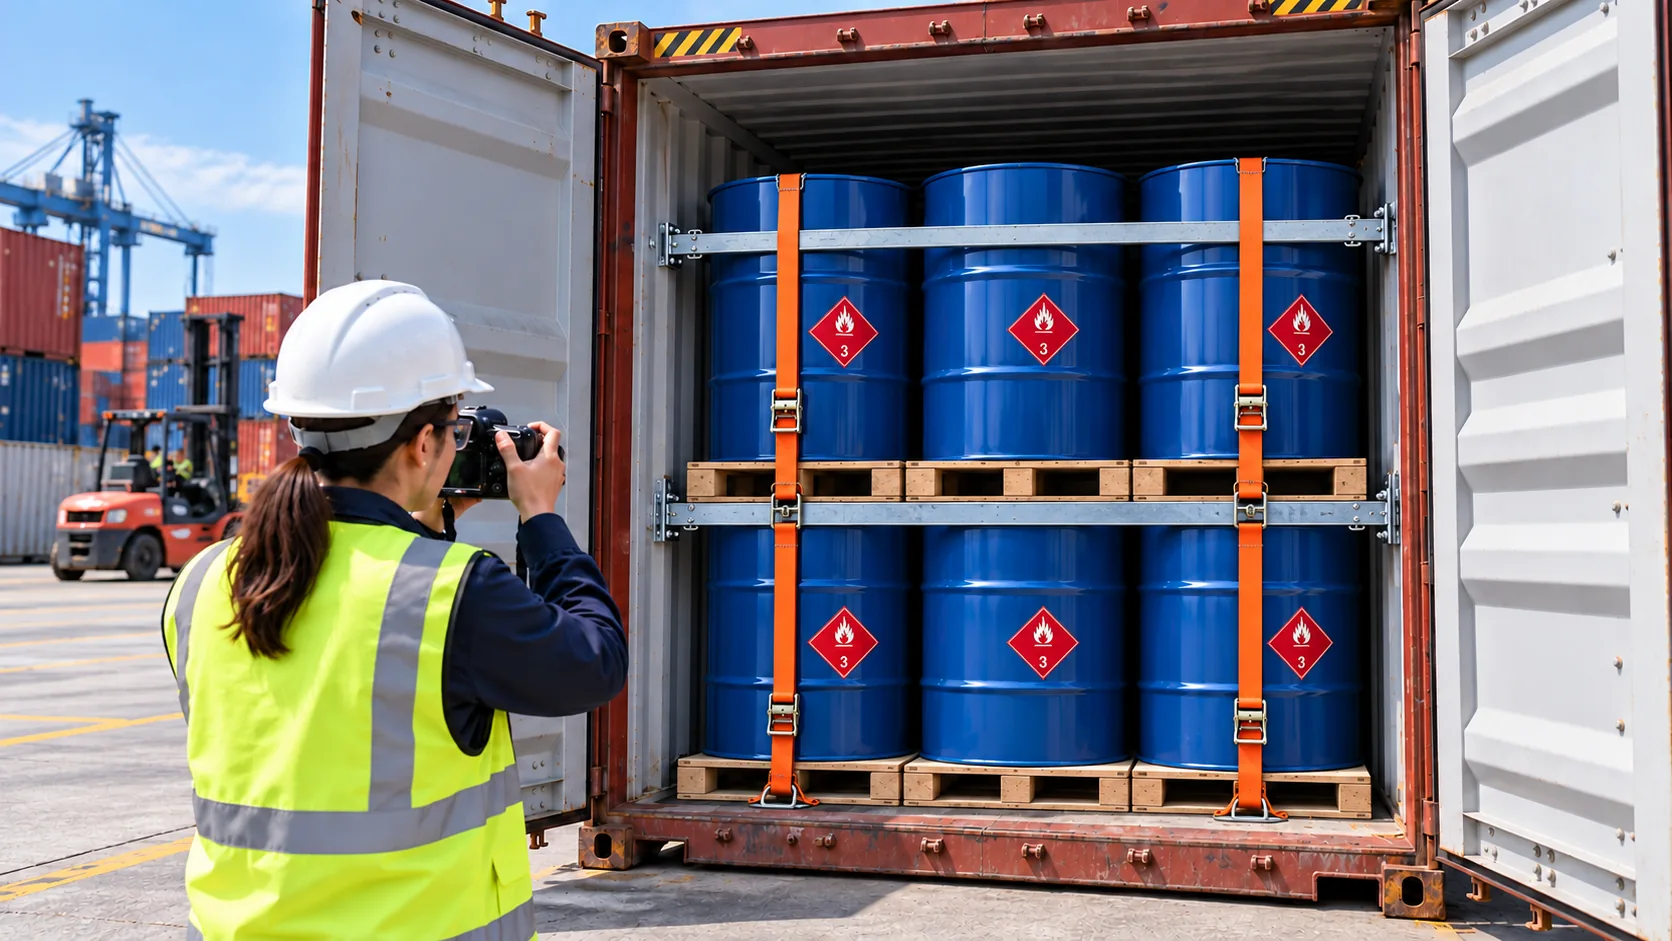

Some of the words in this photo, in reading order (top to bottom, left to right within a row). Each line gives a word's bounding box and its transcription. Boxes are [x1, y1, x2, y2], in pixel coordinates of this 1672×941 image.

[840, 345, 848, 357] 3
[1039, 343, 1048, 355] 3
[1297, 343, 1305, 356] 3
[840, 656, 848, 668] 3
[1039, 656, 1048, 668] 3
[1297, 656, 1305, 668] 3
